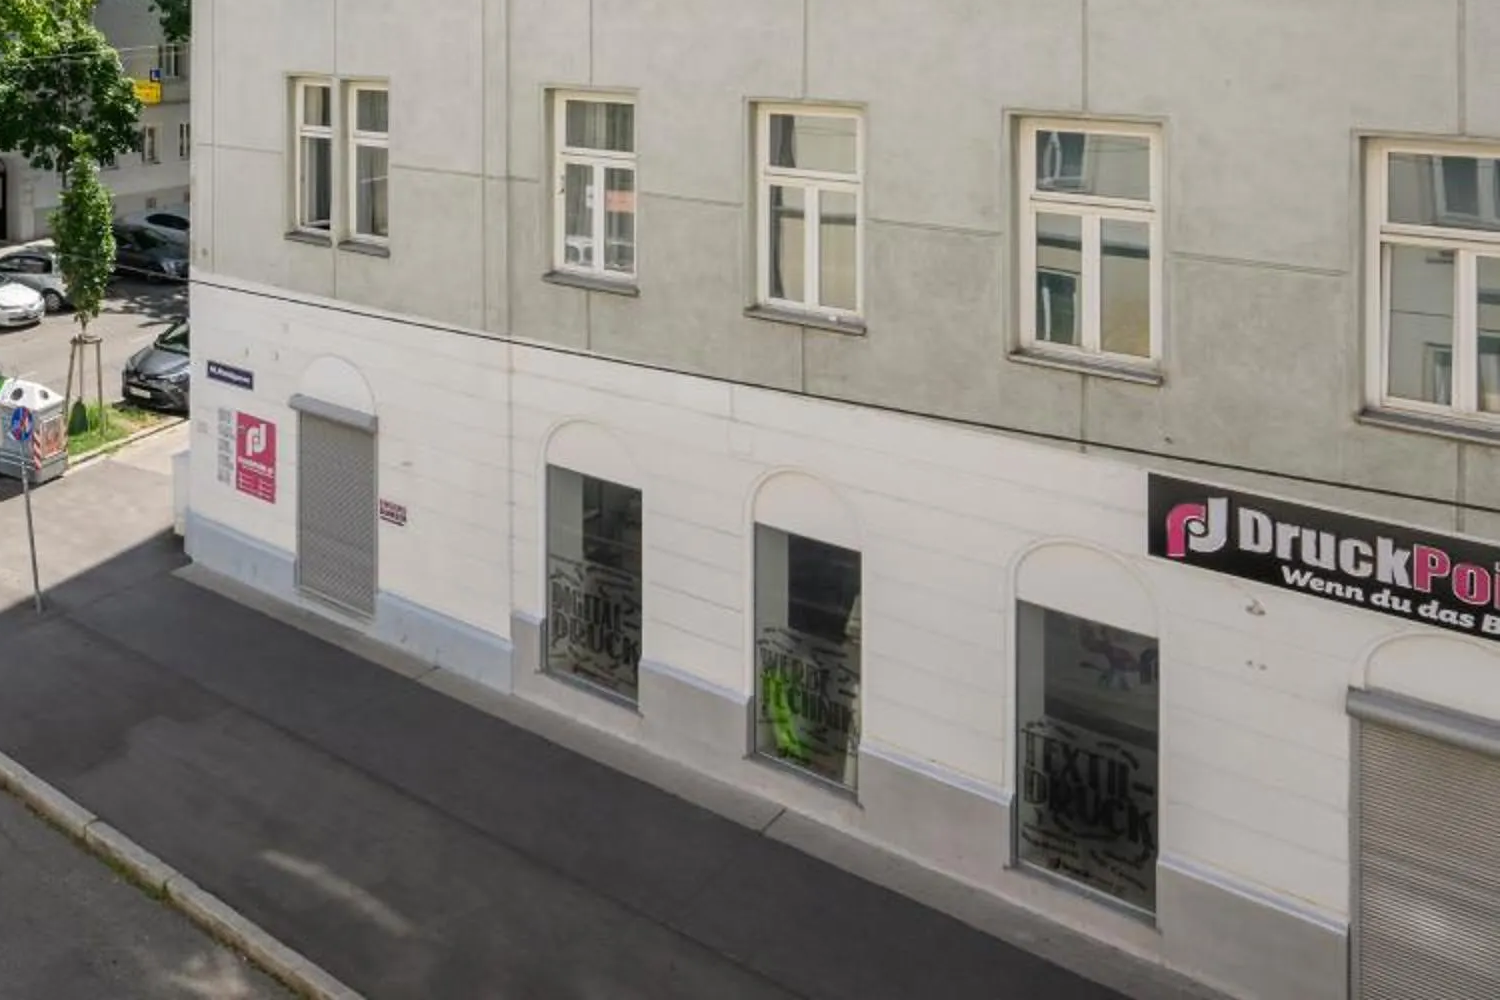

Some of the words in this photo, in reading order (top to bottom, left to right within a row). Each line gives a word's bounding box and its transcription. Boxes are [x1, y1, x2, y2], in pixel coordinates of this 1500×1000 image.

[1280, 565, 1364, 602] Wenn
[1370, 588, 1412, 613] du
[1418, 600, 1476, 628] das
